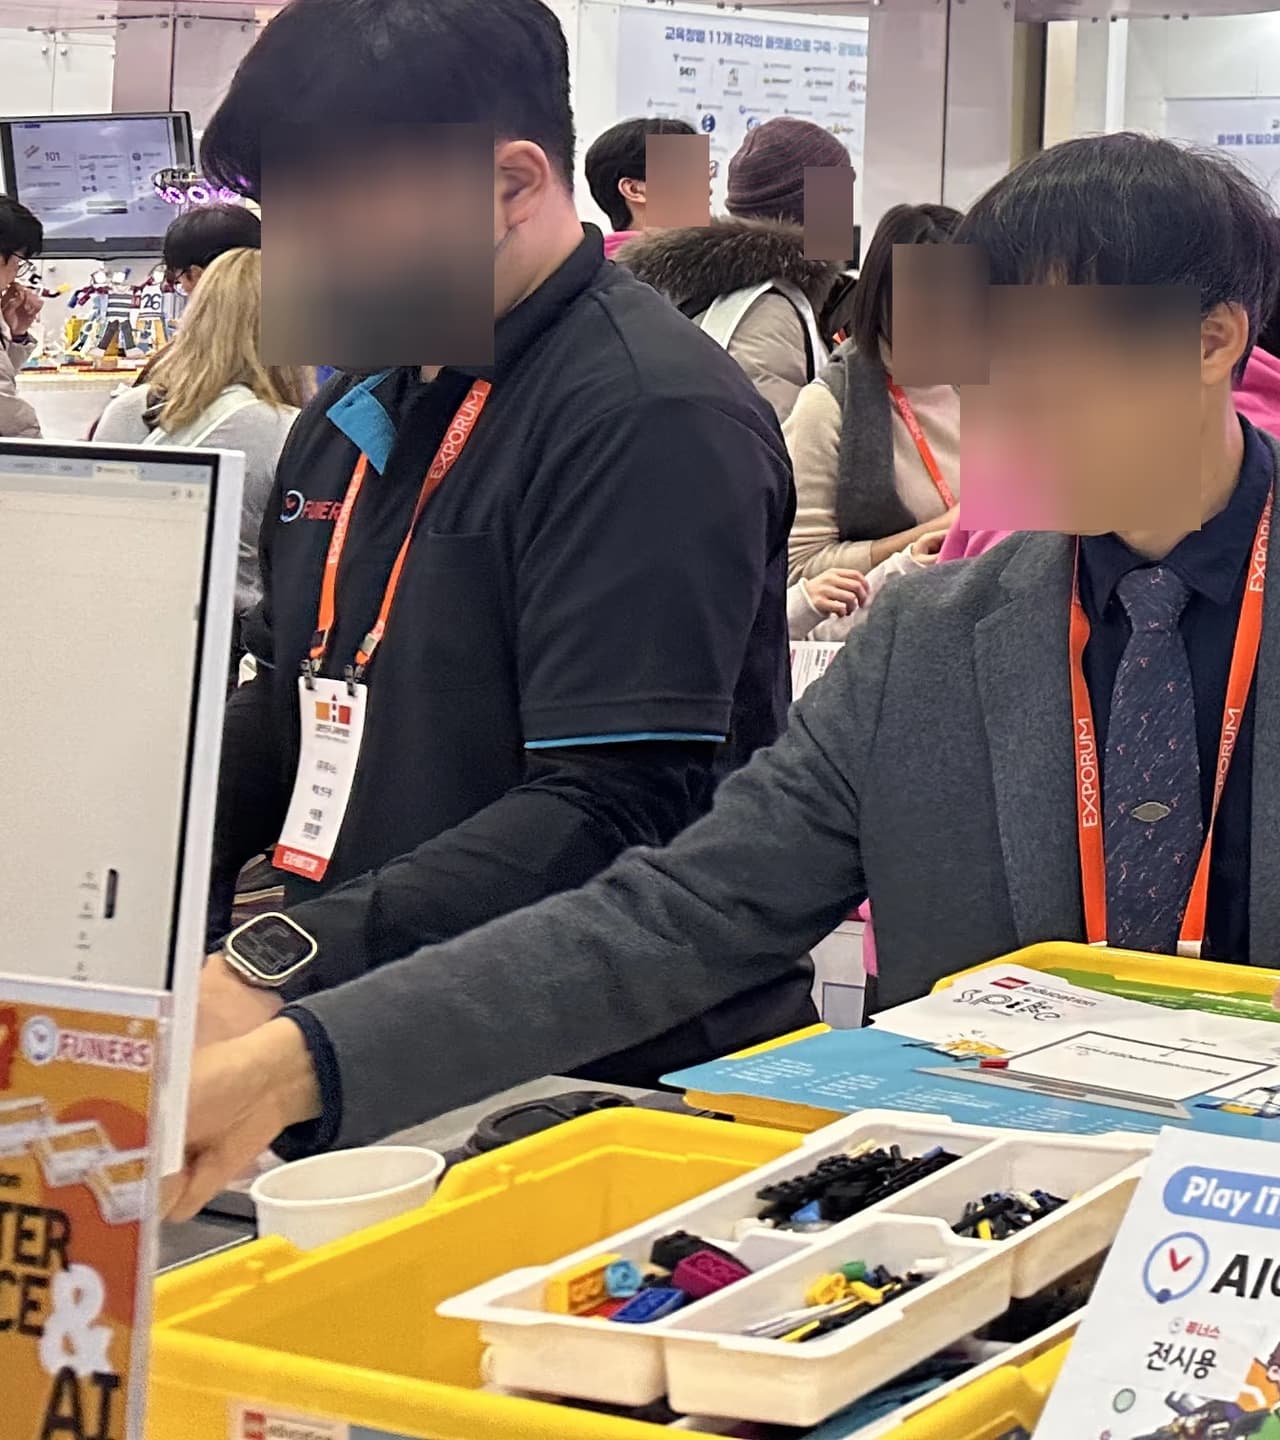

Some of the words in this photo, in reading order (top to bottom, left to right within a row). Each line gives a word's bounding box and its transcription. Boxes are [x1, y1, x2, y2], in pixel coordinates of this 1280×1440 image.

[430, 389, 485, 481] EXPORUM
[1081, 716, 1099, 828] EXPORUM
[1182, 1175, 1251, 1218] Play
[1146, 1340, 1218, 1380] 전시용
